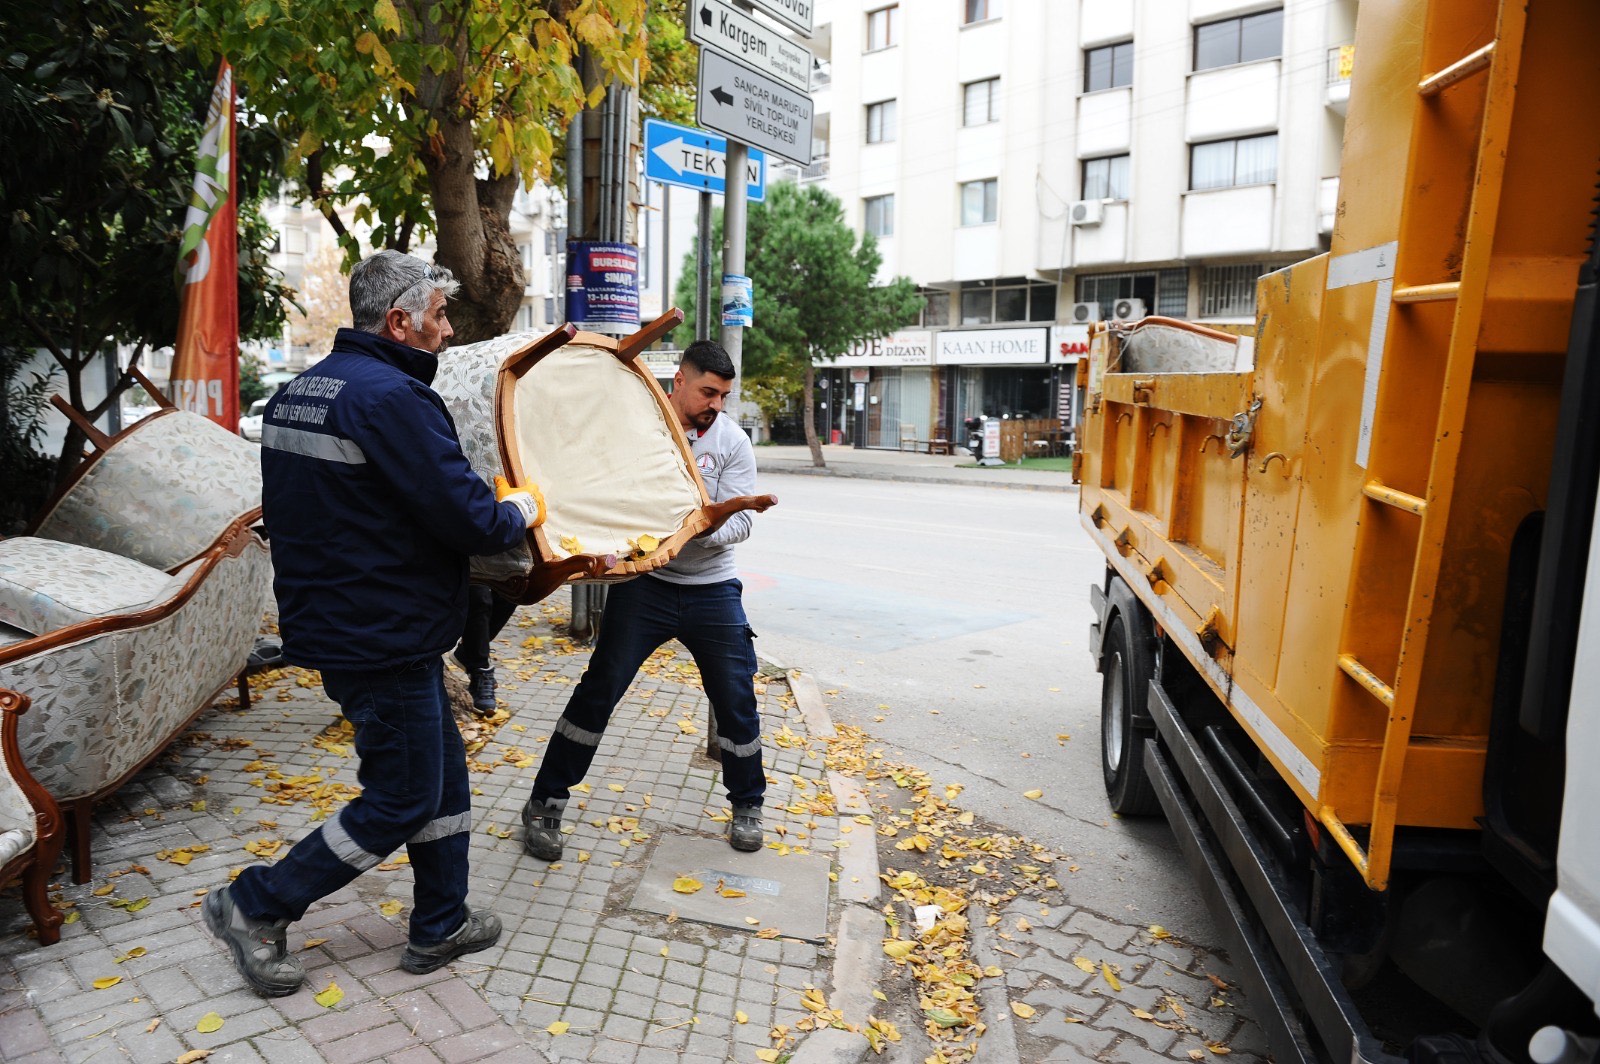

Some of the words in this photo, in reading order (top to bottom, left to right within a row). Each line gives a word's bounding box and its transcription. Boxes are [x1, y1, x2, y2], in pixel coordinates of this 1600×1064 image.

[719, 10, 768, 58] Kargem
[734, 76, 770, 103] SANCAR
[771, 94, 809, 120] MARUFLU
[743, 97, 765, 116] SİVİL
[767, 108, 799, 131] TOPLUM
[745, 114, 796, 146] YERLEŞKESİ
[681, 149, 716, 174] TEK
[886, 345, 926, 357] DİZAYN
[942, 340, 988, 355] KAAN
[990, 338, 1038, 354] HOME
